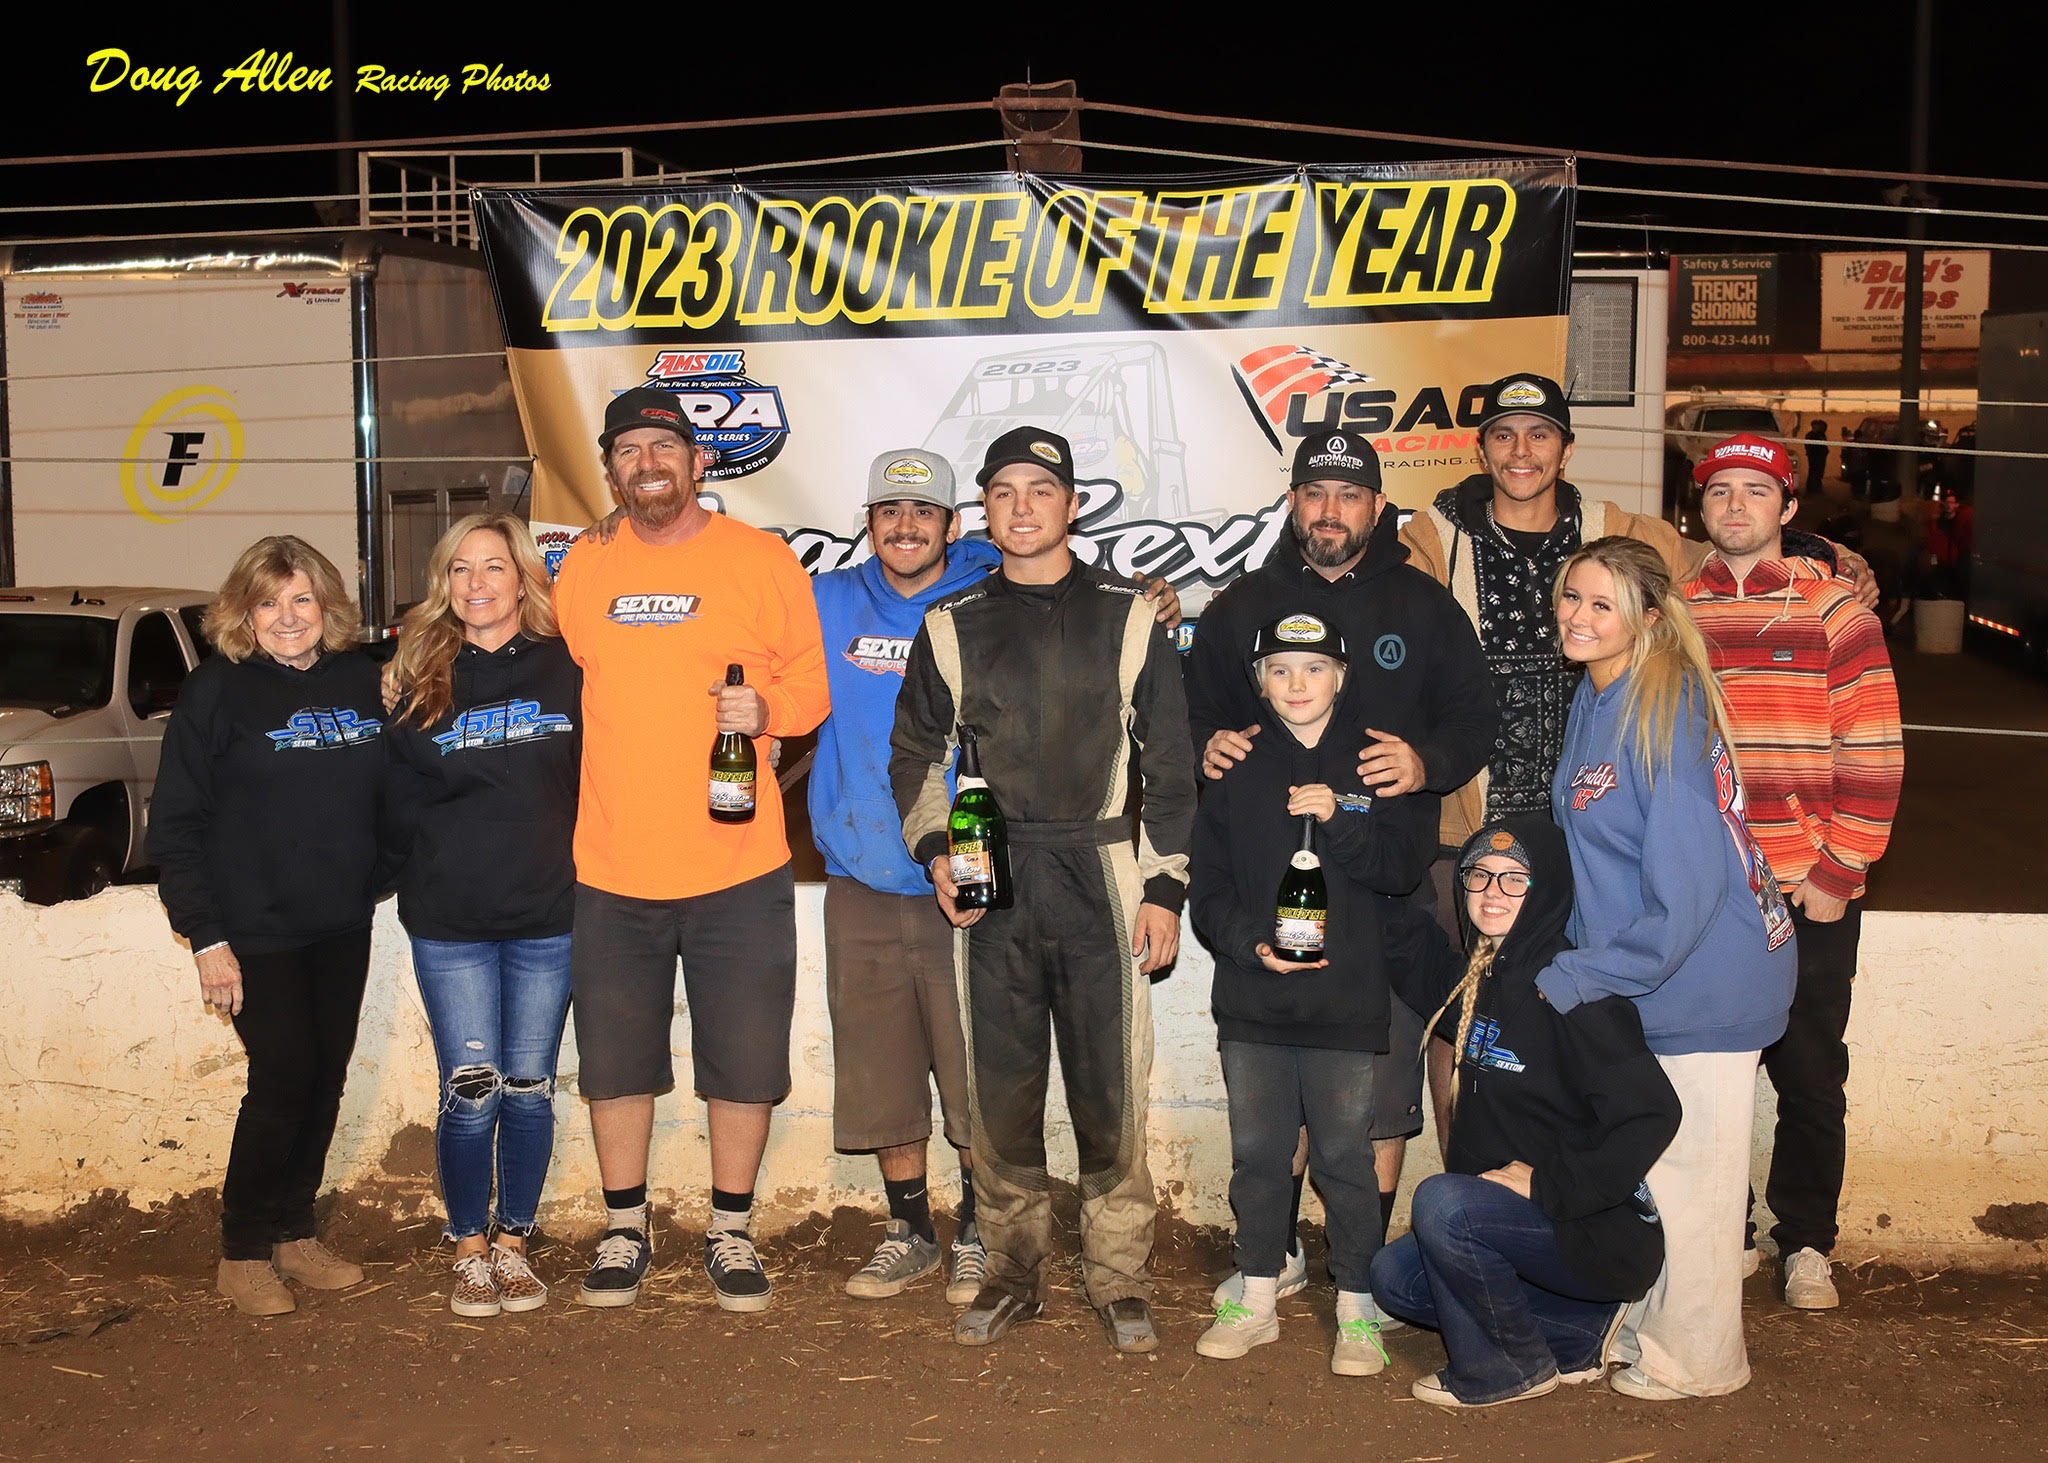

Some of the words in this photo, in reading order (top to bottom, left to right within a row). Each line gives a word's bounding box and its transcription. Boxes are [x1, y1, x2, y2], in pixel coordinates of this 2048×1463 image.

[541, 203, 742, 335] 2023
[734, 192, 1029, 327] ROOKIE
[1023, 188, 1146, 320] OF
[1146, 183, 1301, 315] THE
[1304, 178, 1517, 309] YEAR
[1683, 259, 1718, 271] Safety
[1721, 260, 1729, 269] &
[1732, 259, 1772, 269] Service
[1692, 281, 1757, 301] TRENCH
[1691, 302, 1757, 320] SHORING
[1682, 335, 1771, 346] 800-423-4411
[654, 353, 743, 376] AMSOIL
[982, 360, 1081, 376] 2023
[700, 381, 742, 389] Synthetics
[677, 392, 784, 429] RA
[695, 434, 714, 442] CAR
[717, 434, 750, 442] SERIES
[1372, 433, 1482, 454] ACIN
[162, 432, 206, 487] F
[1308, 454, 1363, 468] AUTOMATED
[1714, 445, 1774, 461] WHELEN
[613, 595, 695, 615] SEXTON
[636, 613, 685, 622] PROTECTION
[292, 740, 317, 748] SEXTON
[1570, 763, 1618, 800] Buddy
[1571, 789, 1595, 810] 67
[1495, 1060, 1526, 1073] SEXTON
